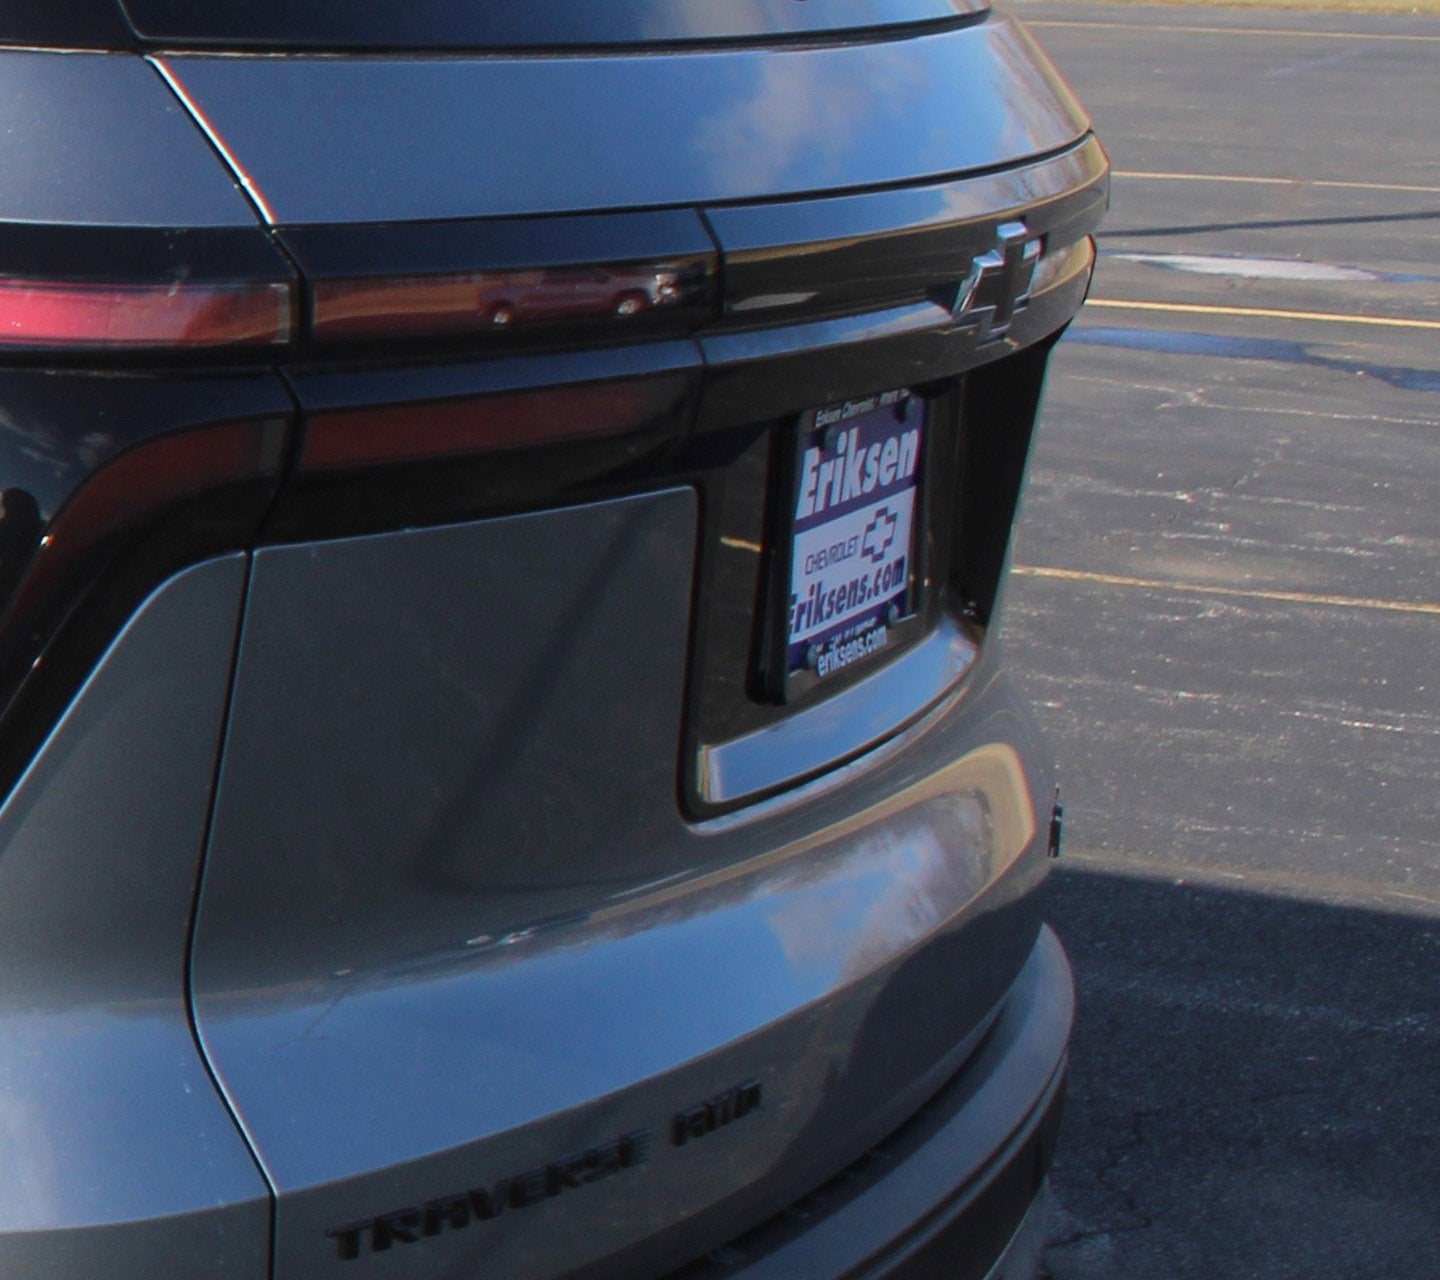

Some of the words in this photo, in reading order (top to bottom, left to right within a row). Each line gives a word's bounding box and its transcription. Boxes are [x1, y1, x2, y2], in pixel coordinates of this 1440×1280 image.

[795, 426, 919, 521] Eriksen
[804, 534, 860, 576] CHEVROLET
[324, 1128, 653, 1262] TRAVERSE
